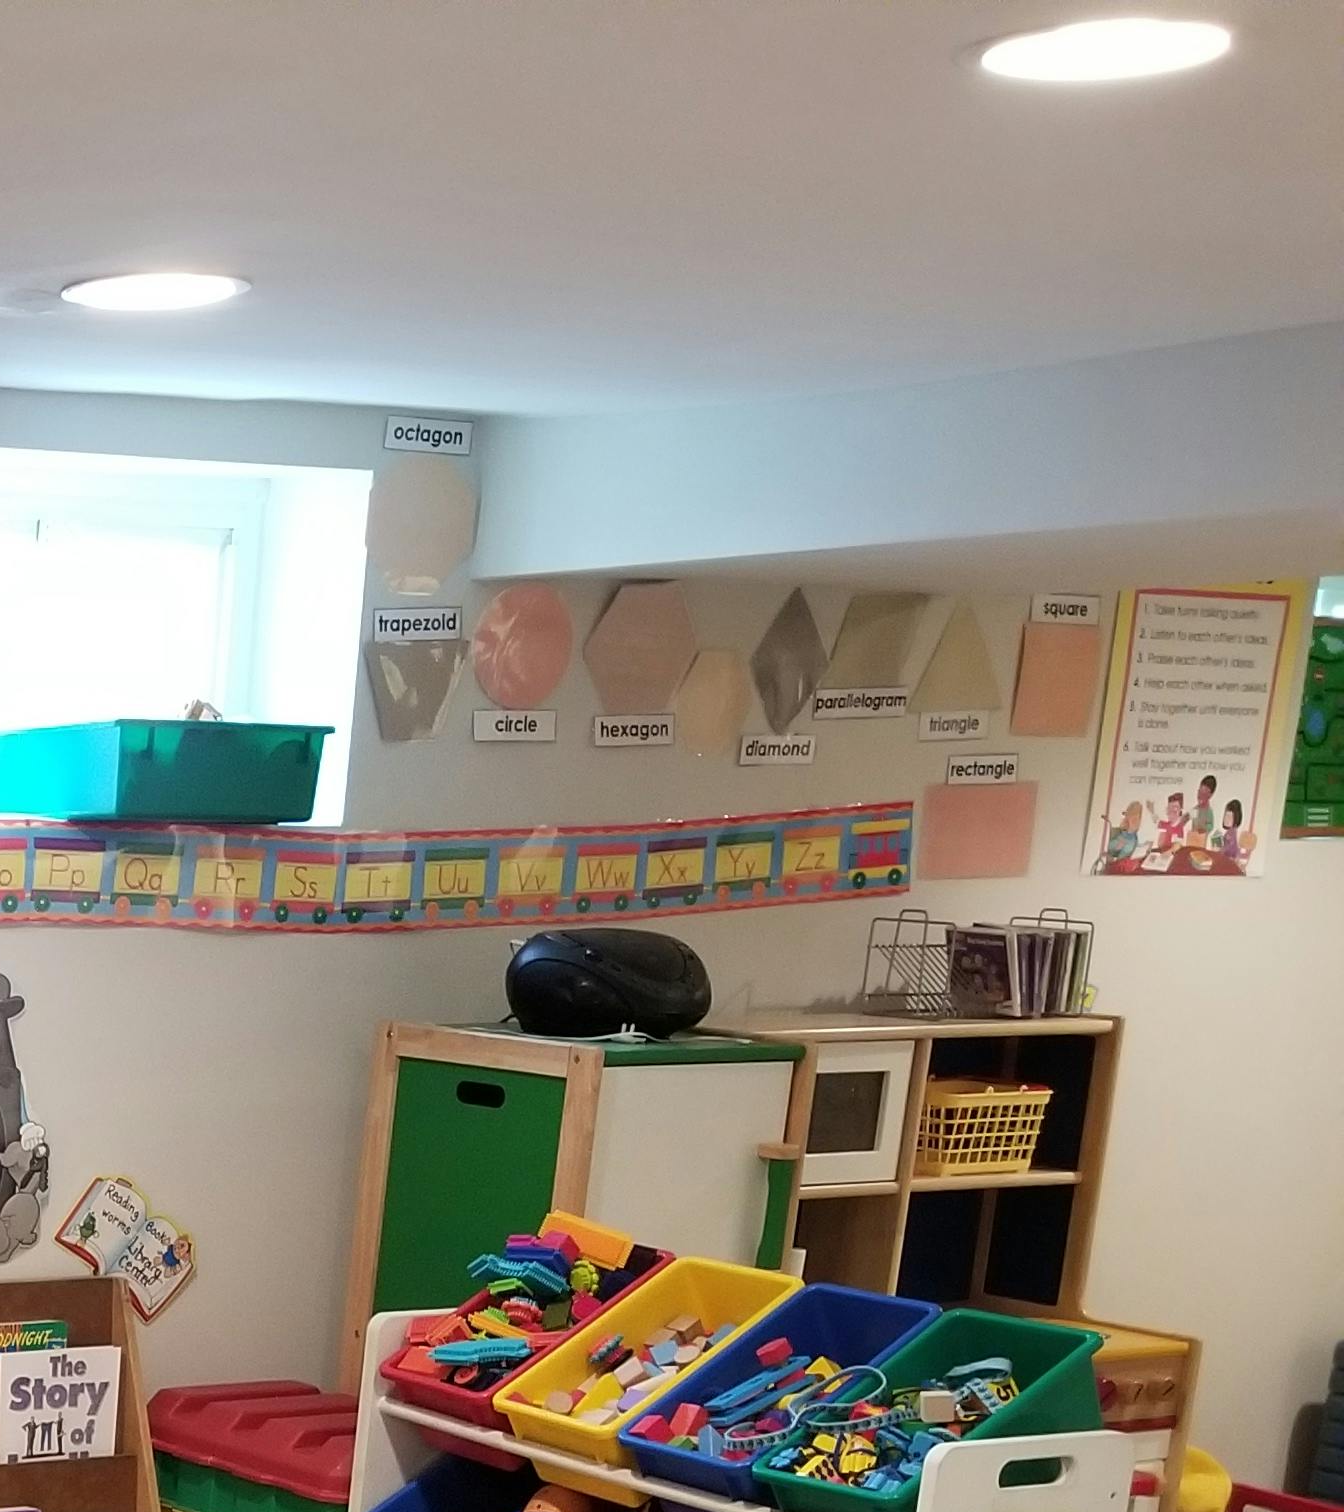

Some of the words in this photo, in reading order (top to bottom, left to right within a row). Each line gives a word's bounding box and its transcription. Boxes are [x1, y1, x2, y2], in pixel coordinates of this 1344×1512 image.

[393, 423, 464, 448] octagon
[1043, 600, 1089, 620] square
[378, 612, 458, 637] trapezoid
[815, 690, 908, 714] parallelogram
[494, 714, 539, 735] circle
[599, 720, 670, 745] hexagon
[928, 713, 981, 735] triangle
[744, 739, 811, 760] diamond
[949, 758, 1016, 780] rectangle
[105, 1183, 140, 1223] Reading
[101, 1209, 132, 1236] worms
[48, 1354, 88, 1379] The
[8, 1375, 111, 1416] Story
[69, 1419, 96, 1446] of
